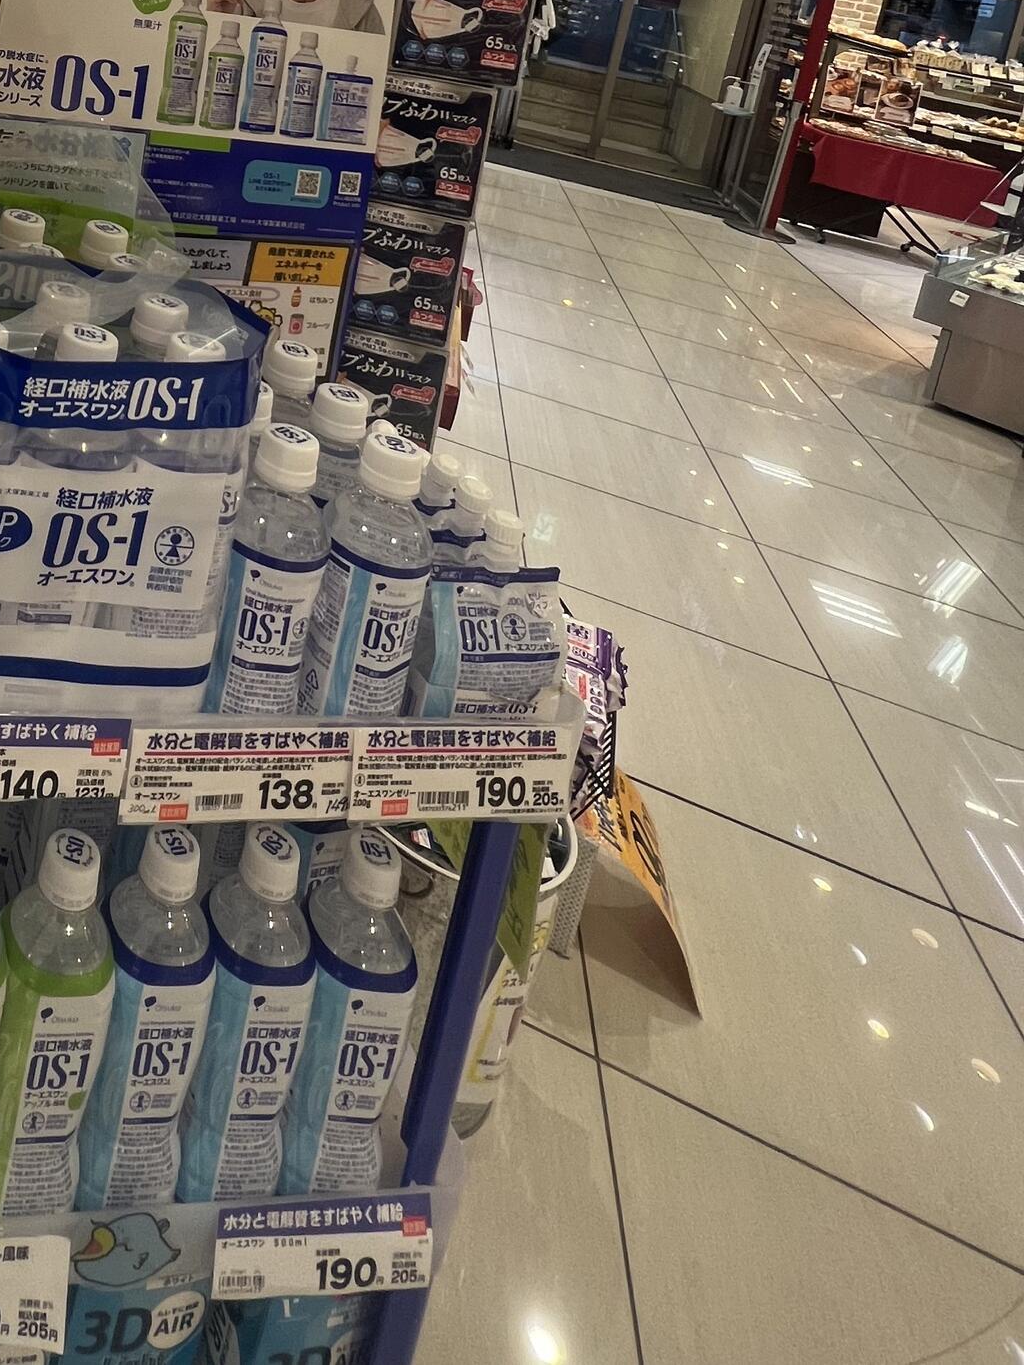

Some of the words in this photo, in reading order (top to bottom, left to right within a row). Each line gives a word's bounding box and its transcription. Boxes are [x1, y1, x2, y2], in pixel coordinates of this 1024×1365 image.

[133, 18, 163, 31] 無果汁
[174, 43, 198, 59] OS-1
[255, 53, 278, 70] OS-1
[51, 54, 150, 120] OS-1
[383, 96, 438, 121] ブふわ
[452, 115, 477, 125] マスク
[426, 244, 451, 255] マスク
[22, 376, 131, 400] 経口補水液
[407, 373, 432, 384] マスク
[127, 376, 205, 422] OS-1
[18, 400, 126, 421] オーエスワン
[55, 485, 154, 510] 経口補水液
[41, 509, 150, 570] OS-1
[37, 568, 134, 587] オーエスワン
[244, 596, 293, 614] 経口補水液
[238, 608, 291, 646] OS-1
[362, 617, 408, 652] OS-1
[459, 618, 501, 652] OS-1
[235, 640, 285, 656] オーエスワン
[146, 731, 350, 751] 水分と電解質をすばやく補給
[367, 730, 556, 748] 水分と電解質をすばやく補給
[134, 792, 181, 801] オーエスワン
[352, 798, 372, 809] 200g
[353, 789, 416, 798] オーエスワンゼリー
[138, 1027, 194, 1040] 経口補水液
[246, 1027, 302, 1040] 経口補水液
[344, 1030, 399, 1045] 経口補水液
[32, 1038, 93, 1053] 経口補水液
[132, 1041, 191, 1078] OS-1
[240, 1040, 299, 1076] OS-1
[338, 1043, 398, 1080] OS-1
[26, 1053, 90, 1090] OS-1
[223, 1205, 404, 1231] 水分と電解質をすばやく補給
[221, 1238, 266, 1249] オーエスワン
[75, 1308, 152, 1355] 3D
[153, 1312, 195, 1337] AIR
